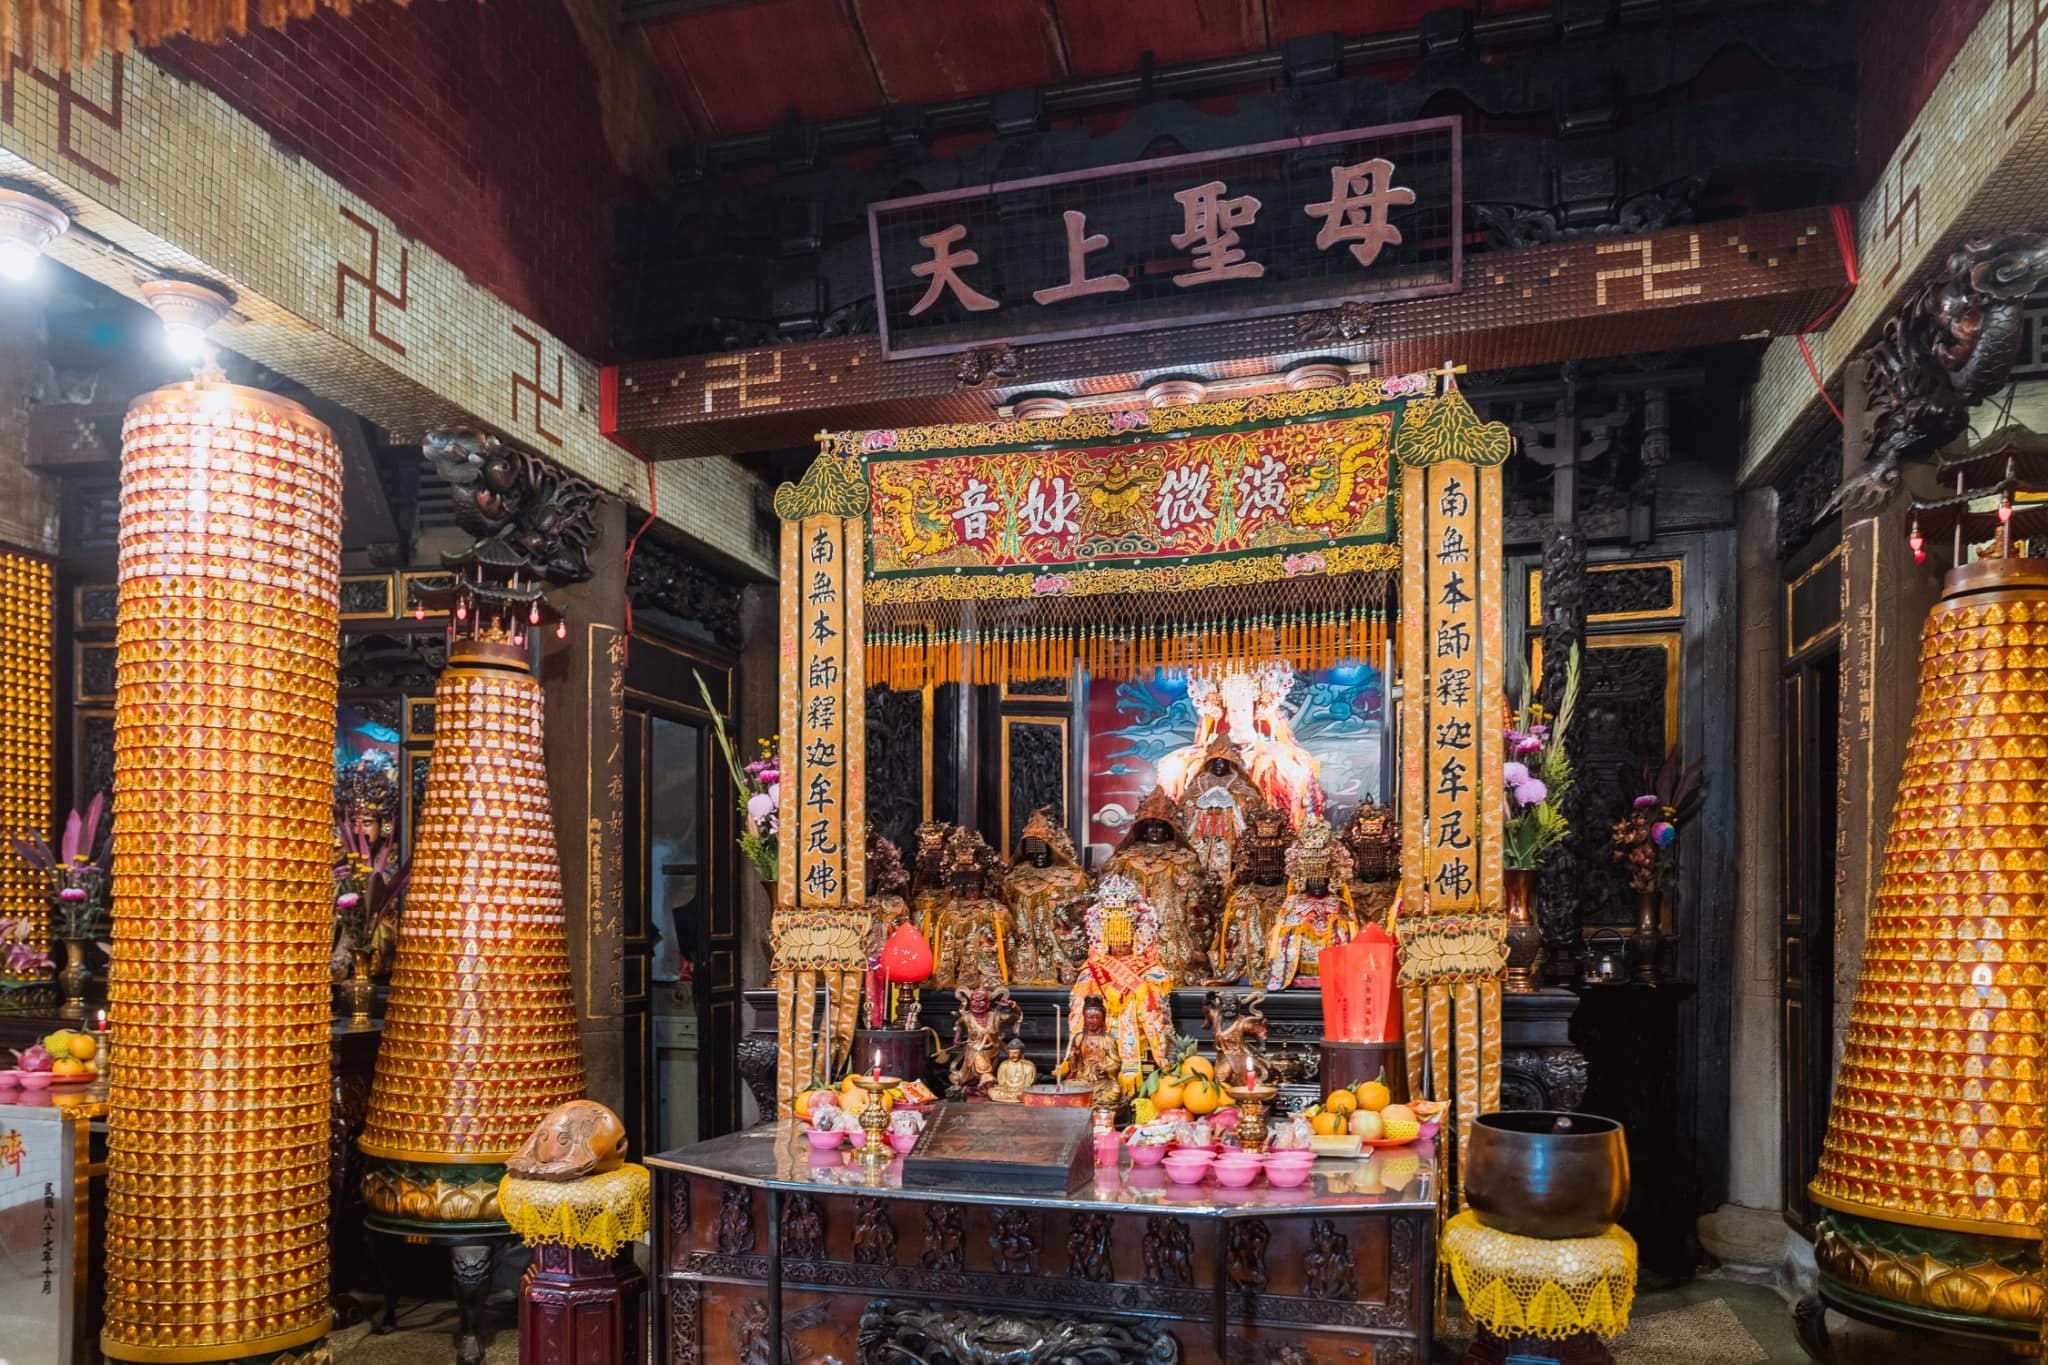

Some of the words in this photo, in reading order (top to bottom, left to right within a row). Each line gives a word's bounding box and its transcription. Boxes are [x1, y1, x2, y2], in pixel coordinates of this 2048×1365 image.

[909, 158, 1416, 316] 天上聖母
[805, 528, 838, 899] 南無本師釋迦牟尼佛
[1434, 477, 1472, 900] 南無本師釋迦牟尼佛
[41, 1182, 55, 1295] 民國八十七年十月
